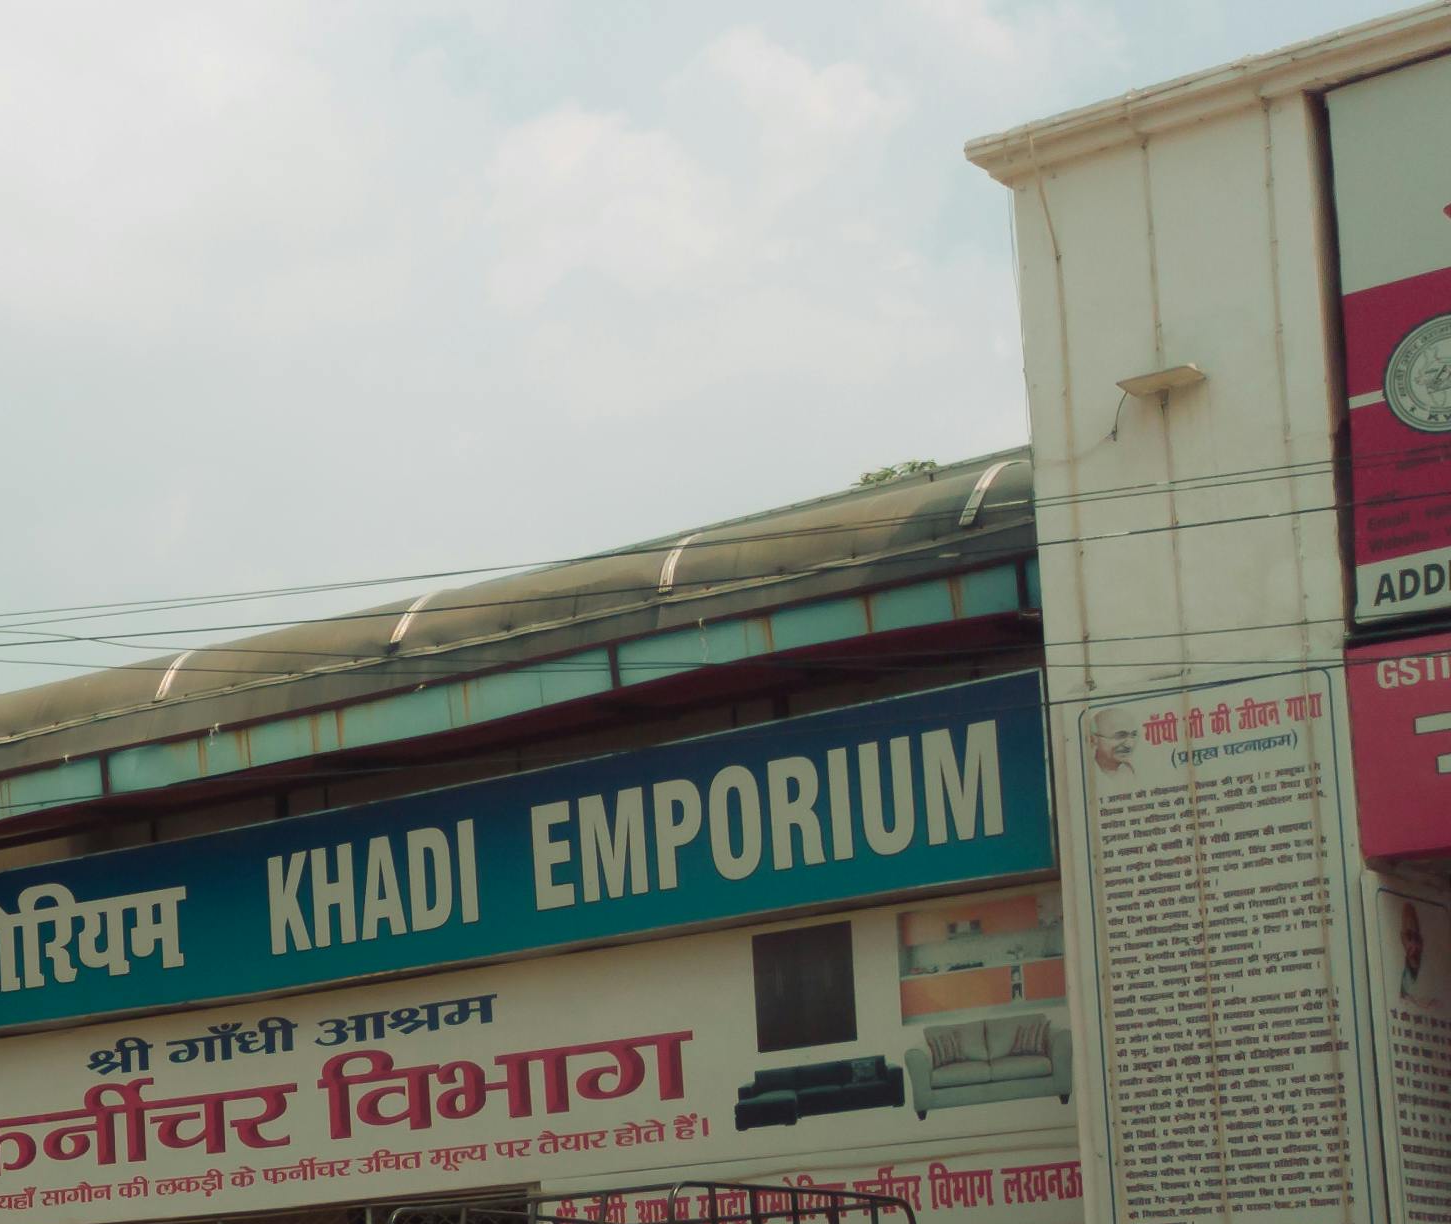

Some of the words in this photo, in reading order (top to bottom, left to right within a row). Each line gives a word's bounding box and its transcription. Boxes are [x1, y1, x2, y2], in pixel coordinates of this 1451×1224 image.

[1373, 560, 1451, 607] ADD
[1209, 703, 1231, 734] की
[1235, 698, 1280, 730] जीवन
[267, 818, 480, 955] KHADI
[531, 720, 1005, 912] EMPORIUM
[88, 1037, 153, 1075] श्री
[167, 1016, 298, 1063] गाँधी
[314, 993, 497, 1047] आश्रम
[317, 1029, 694, 1141] विभाग
[41, 1179, 112, 1210] सागौन
[118, 1174, 153, 1199] की
[156, 1169, 223, 1198] लकड़ी
[230, 1165, 256, 1190] के
[262, 1156, 351, 1186] फर्नीचर
[357, 1148, 422, 1175] उचित
[428, 1143, 488, 1172] मूल्य
[494, 1137, 533, 1160] पर
[538, 1128, 608, 1156] तैयार
[614, 1119, 666, 1147] होते
[928, 1162, 994, 1210] विभाग
